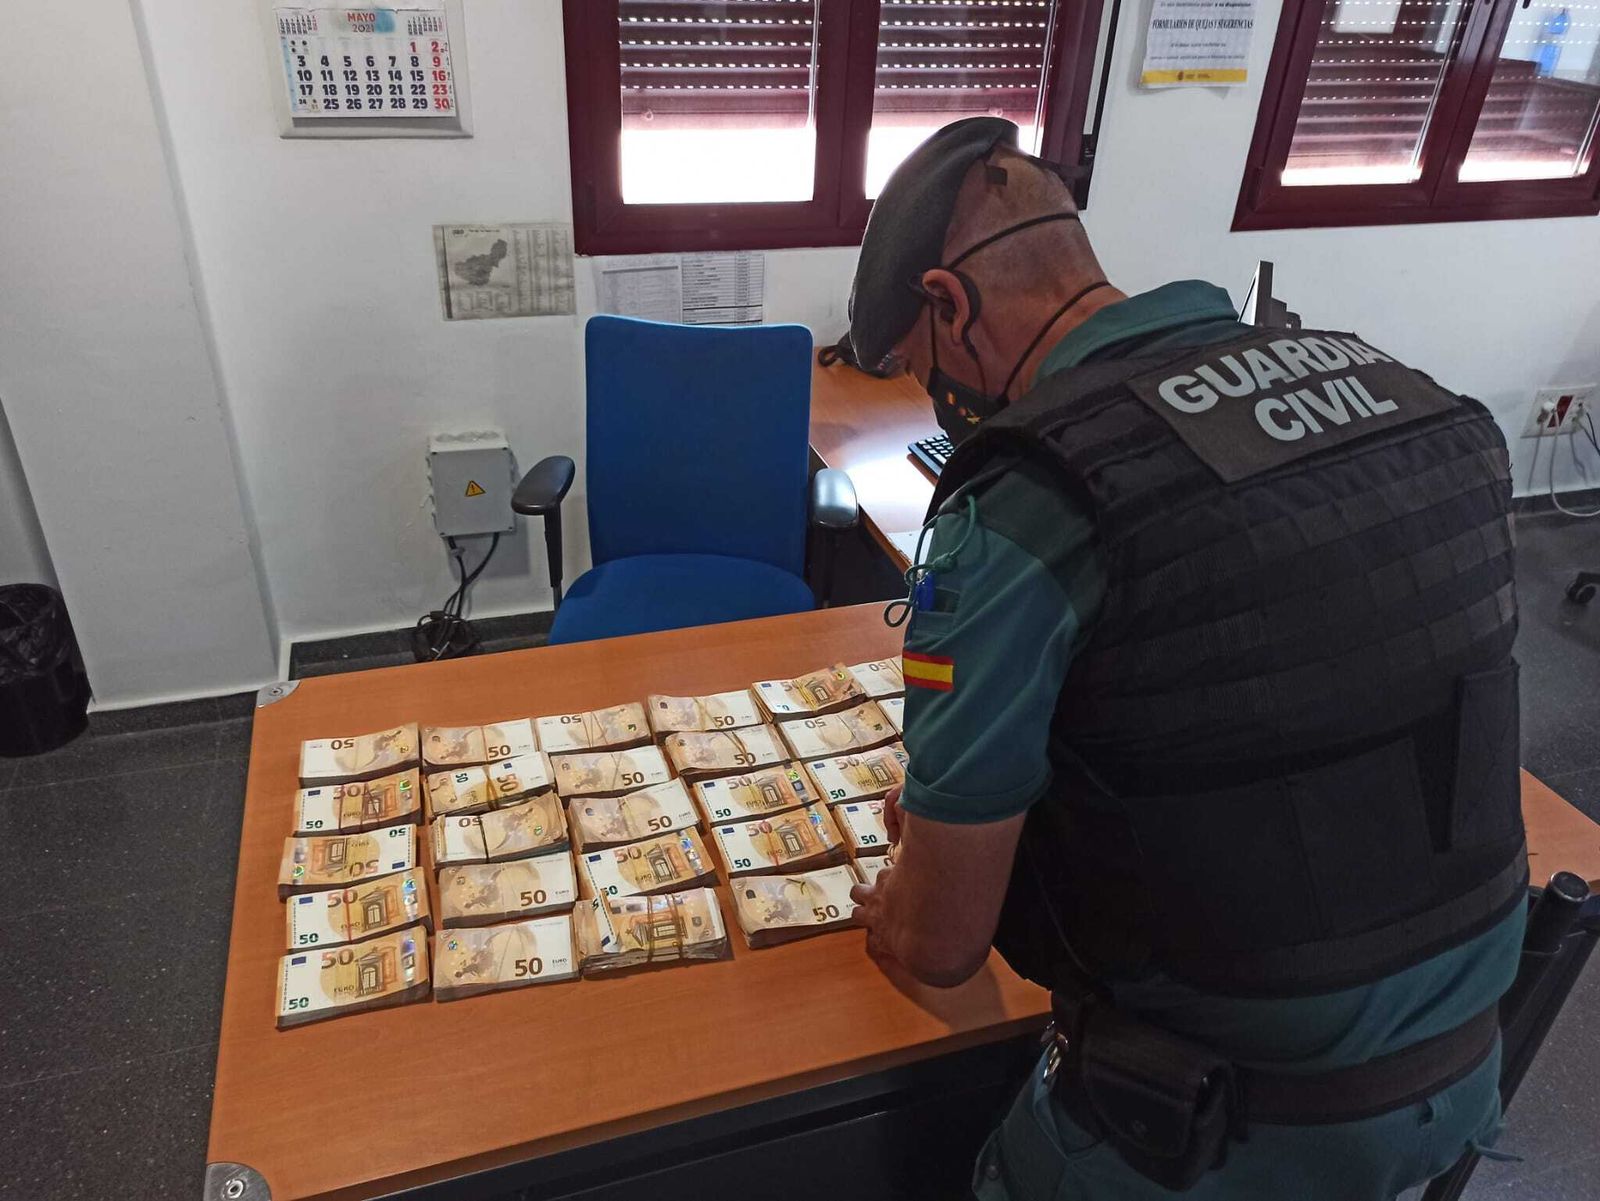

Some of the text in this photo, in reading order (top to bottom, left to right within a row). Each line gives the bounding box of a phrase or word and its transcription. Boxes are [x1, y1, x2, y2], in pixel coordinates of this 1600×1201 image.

[347, 12, 375, 22] MAYO
[352, 24, 374, 32] 2021
[410, 42, 439, 52] 1 2
[297, 56, 441, 67] 3 4 5 6 7 8 9
[297, 70, 446, 81] 10 11 12 13 14 15 16
[300, 84, 448, 95] 17 18 19 20 21 22 23
[324, 98, 339, 109] 25
[346, 98, 362, 109] 26
[369, 98, 383, 109] 27
[390, 98, 406, 109] 28
[412, 98, 428, 109] 29
[434, 98, 450, 109] 30
[1159, 337, 1394, 413] GUARDIA
[1255, 376, 1399, 441] CIVIL
[560, 715, 582, 724] 50
[713, 716, 734, 727] 50
[805, 718, 826, 729] 50
[331, 739, 354, 750] 50
[488, 745, 511, 758] 50
[734, 752, 756, 765] 50
[456, 772, 468, 783] 50
[497, 773, 518, 792] 50
[621, 772, 645, 786] 50
[830, 788, 846, 799] 50
[716, 808, 731, 818] 50
[306, 820, 323, 829] 50
[458, 816, 482, 828] 50
[648, 815, 672, 832] 50
[390, 828, 406, 837] 50
[747, 821, 772, 837] 50
[861, 834, 877, 845] 50
[614, 846, 642, 864] 50
[349, 859, 379, 877] 50
[734, 858, 751, 868] 50
[327, 889, 358, 908] 50
[520, 890, 546, 907] 50
[812, 904, 840, 922] 50
[300, 933, 319, 944] 50
[321, 949, 354, 969] 50
[515, 957, 543, 977] 50
[289, 997, 309, 1010] 50
